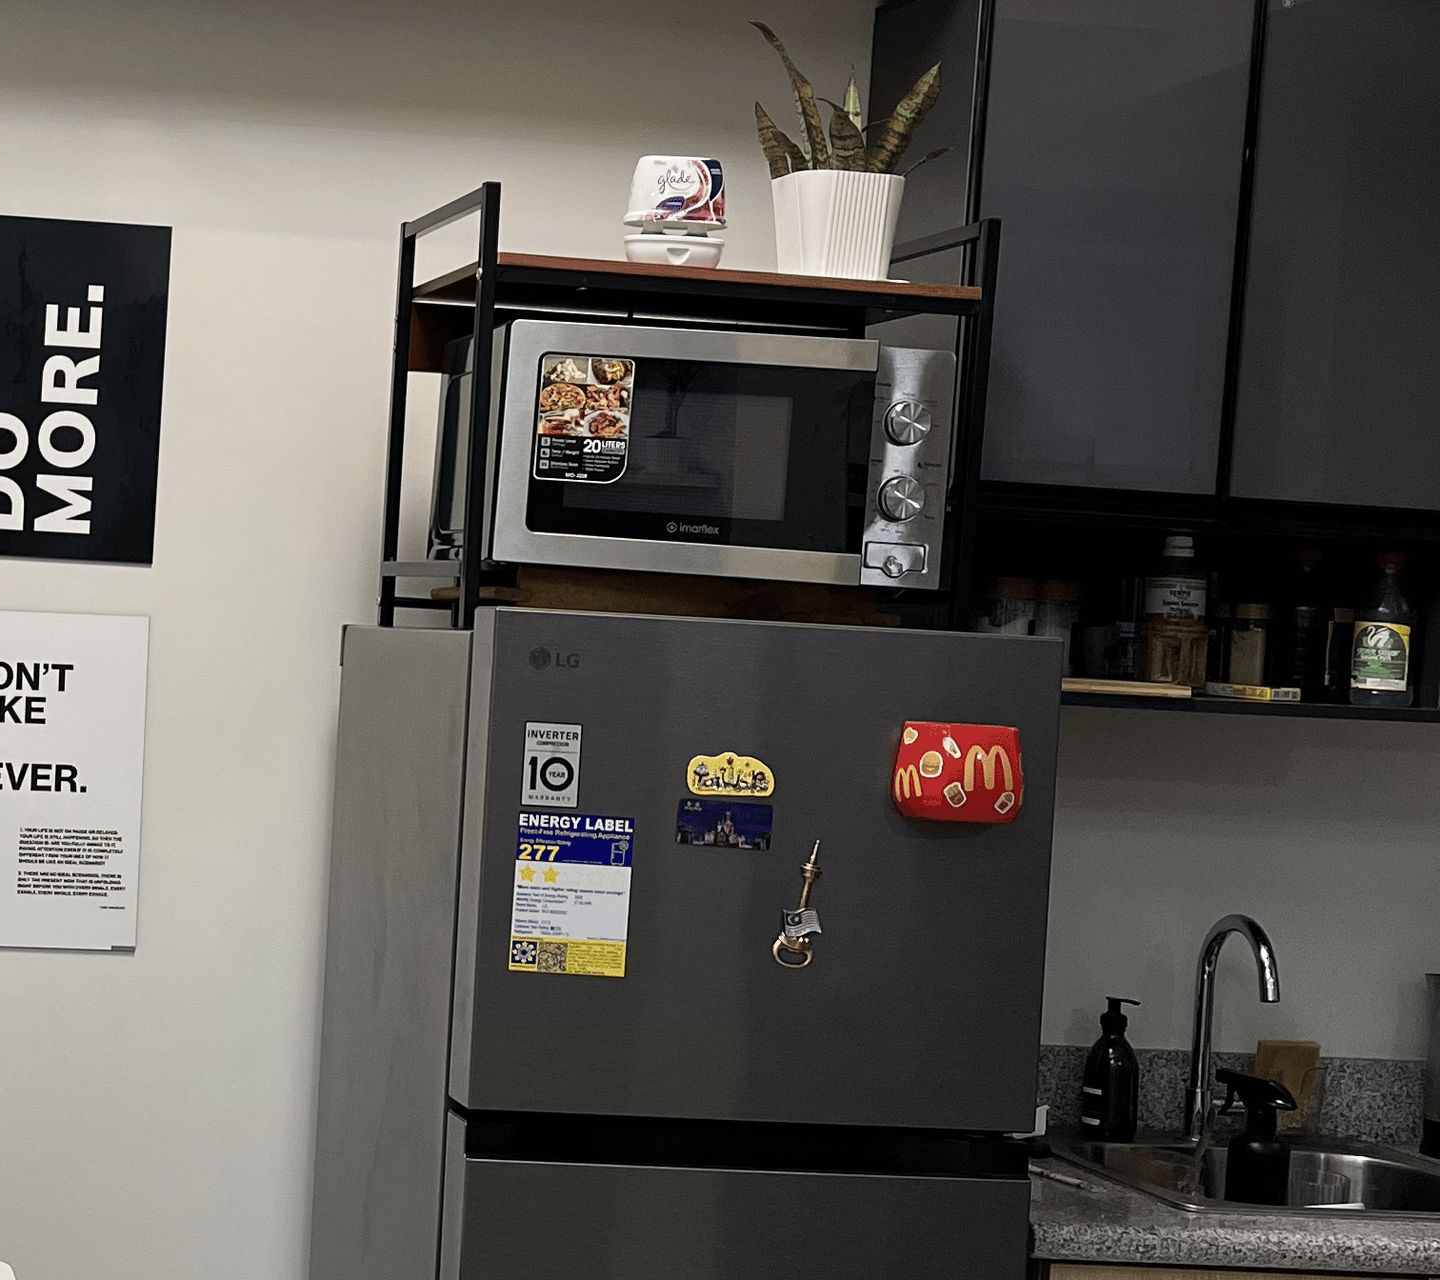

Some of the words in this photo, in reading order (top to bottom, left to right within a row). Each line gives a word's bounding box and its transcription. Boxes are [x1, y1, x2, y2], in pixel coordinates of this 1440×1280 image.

[658, 169, 696, 194] glade
[34, 284, 106, 534] MORE.
[583, 439, 601, 453] 20
[601, 440, 626, 449] LITERS
[556, 652, 580, 668] LG
[527, 729, 579, 741] INVERTER
[529, 756, 574, 792] 10
[519, 813, 581, 829] ENERGY
[585, 817, 633, 833] LABEL
[518, 844, 560, 861] 277
